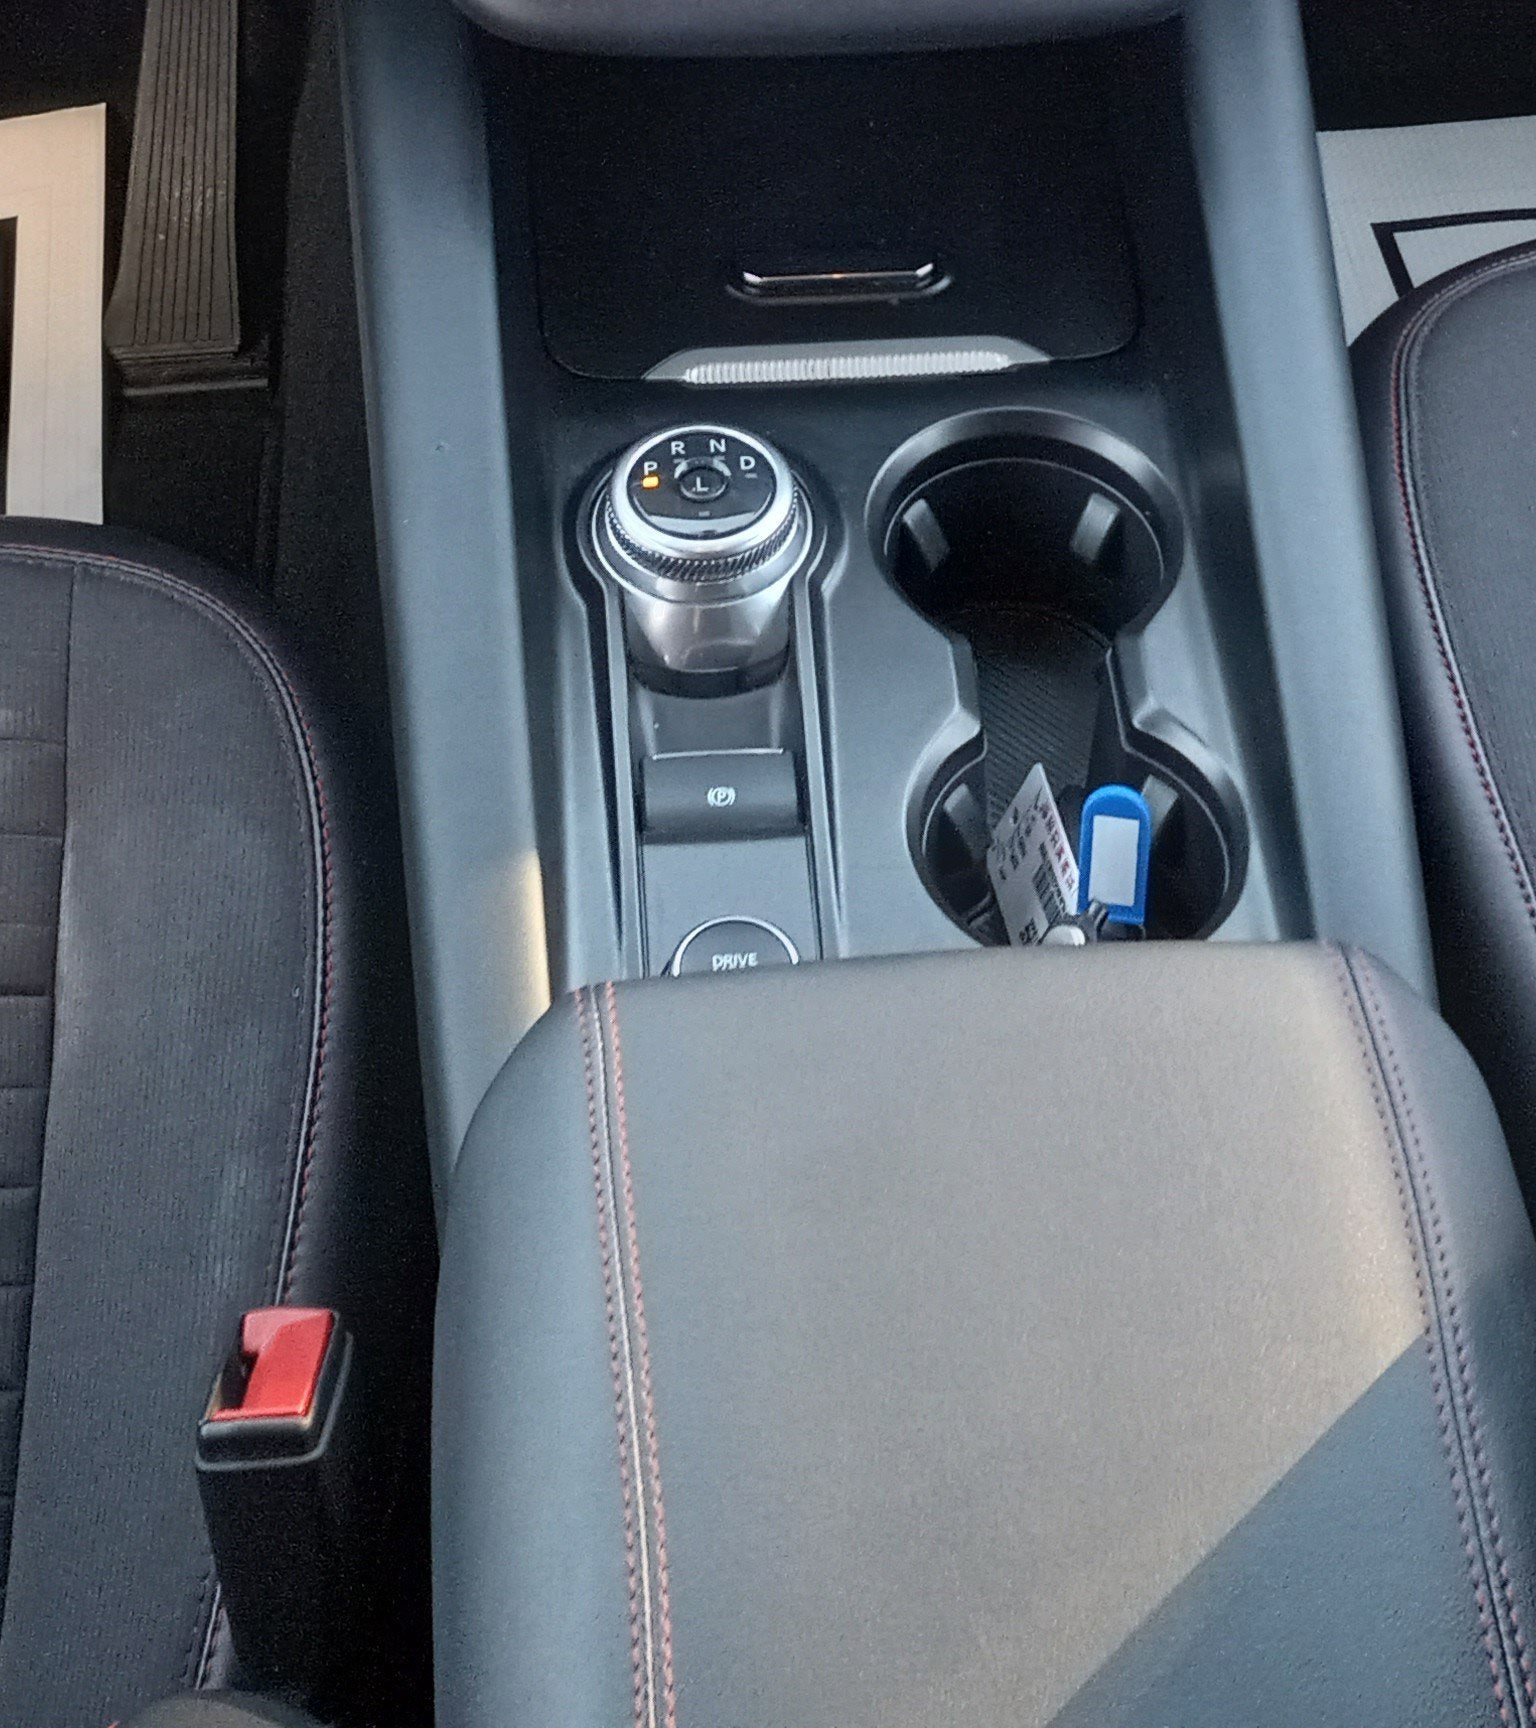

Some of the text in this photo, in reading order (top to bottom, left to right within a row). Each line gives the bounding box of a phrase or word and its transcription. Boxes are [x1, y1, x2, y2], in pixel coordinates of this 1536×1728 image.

[644, 438, 755, 476] P R N D
[695, 477, 709, 492] L
[712, 952, 759, 971] DRIVE
